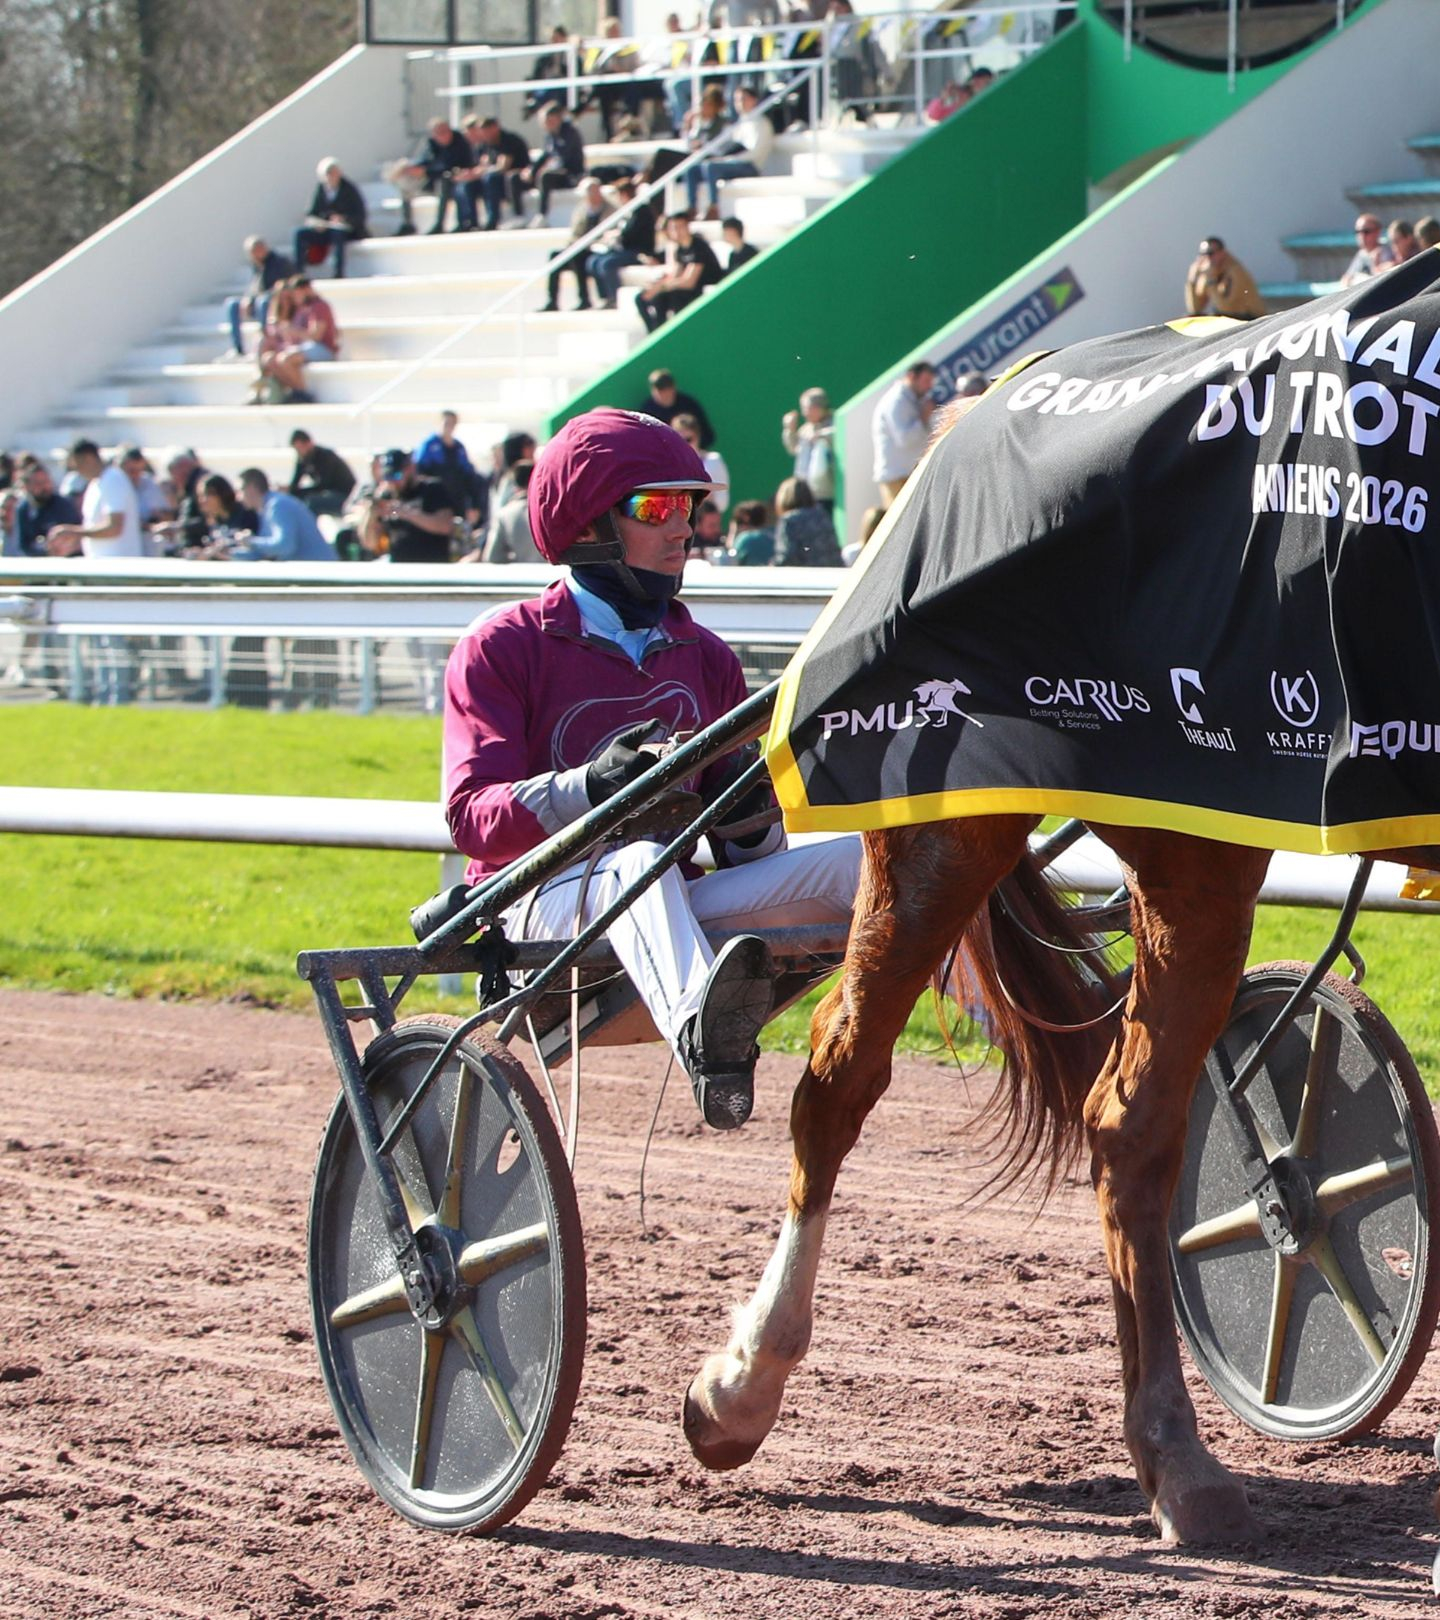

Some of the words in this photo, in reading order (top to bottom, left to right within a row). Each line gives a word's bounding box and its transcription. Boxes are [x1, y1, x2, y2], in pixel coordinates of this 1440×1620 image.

[931, 296, 1049, 403] staurant
[1006, 368, 1192, 416] GRAN
[1197, 374, 1276, 441] DU
[1290, 371, 1440, 456] TROT
[1345, 472, 1429, 533] 2026
[817, 700, 914, 741] PMU
[1024, 676, 1151, 722] CARRUS
[1029, 708, 1060, 719] Betting
[1061, 709, 1099, 719] Solutions
[1066, 720, 1101, 730] Services
